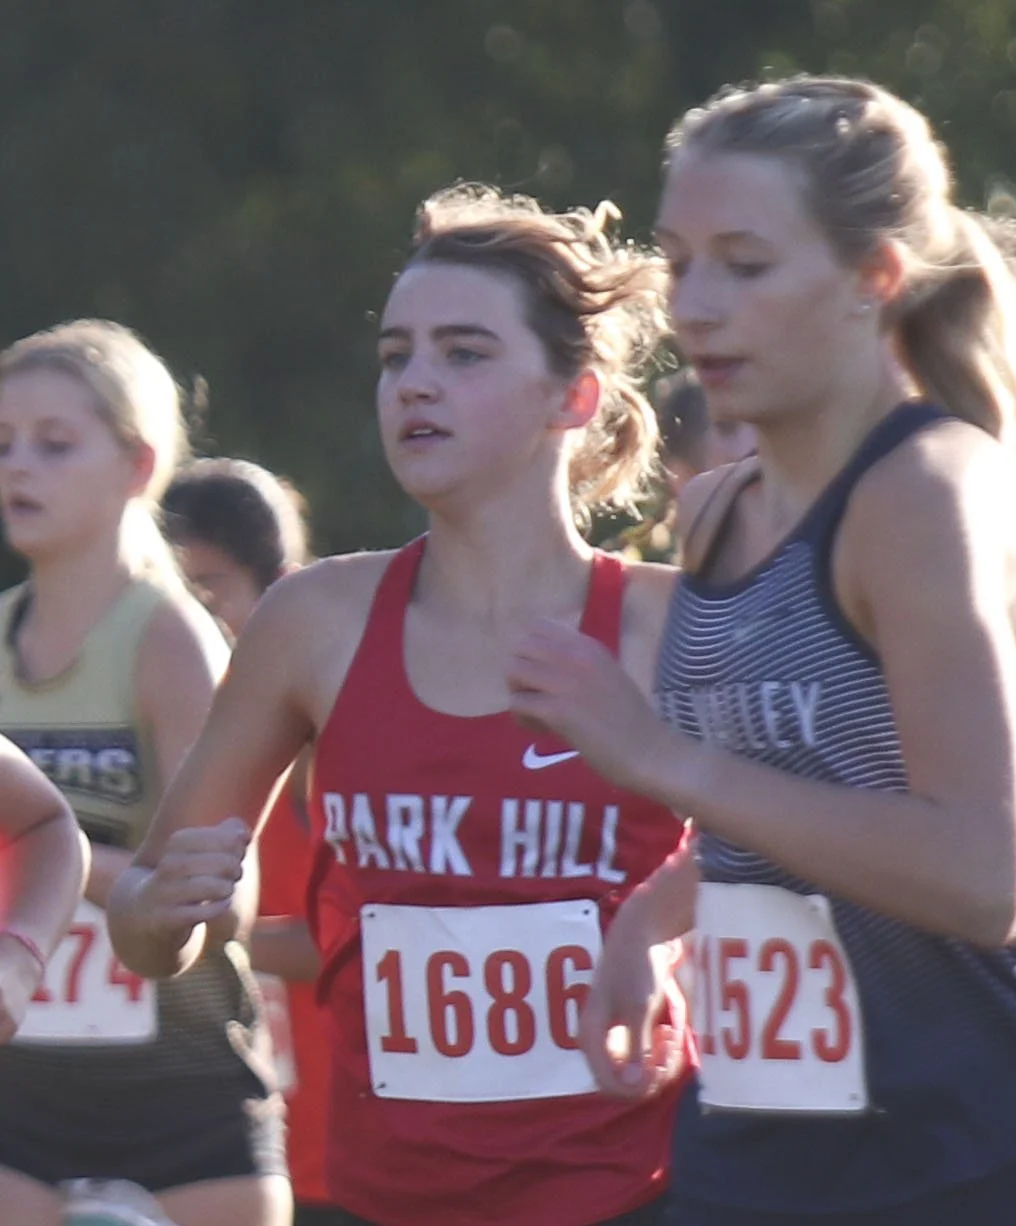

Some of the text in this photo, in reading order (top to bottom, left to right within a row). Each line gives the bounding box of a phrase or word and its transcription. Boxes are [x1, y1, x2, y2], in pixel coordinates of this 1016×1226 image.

[323, 792, 628, 884] PARK HILL
[376, 945, 593, 1059] 1686
[692, 935, 851, 1063] 1523
